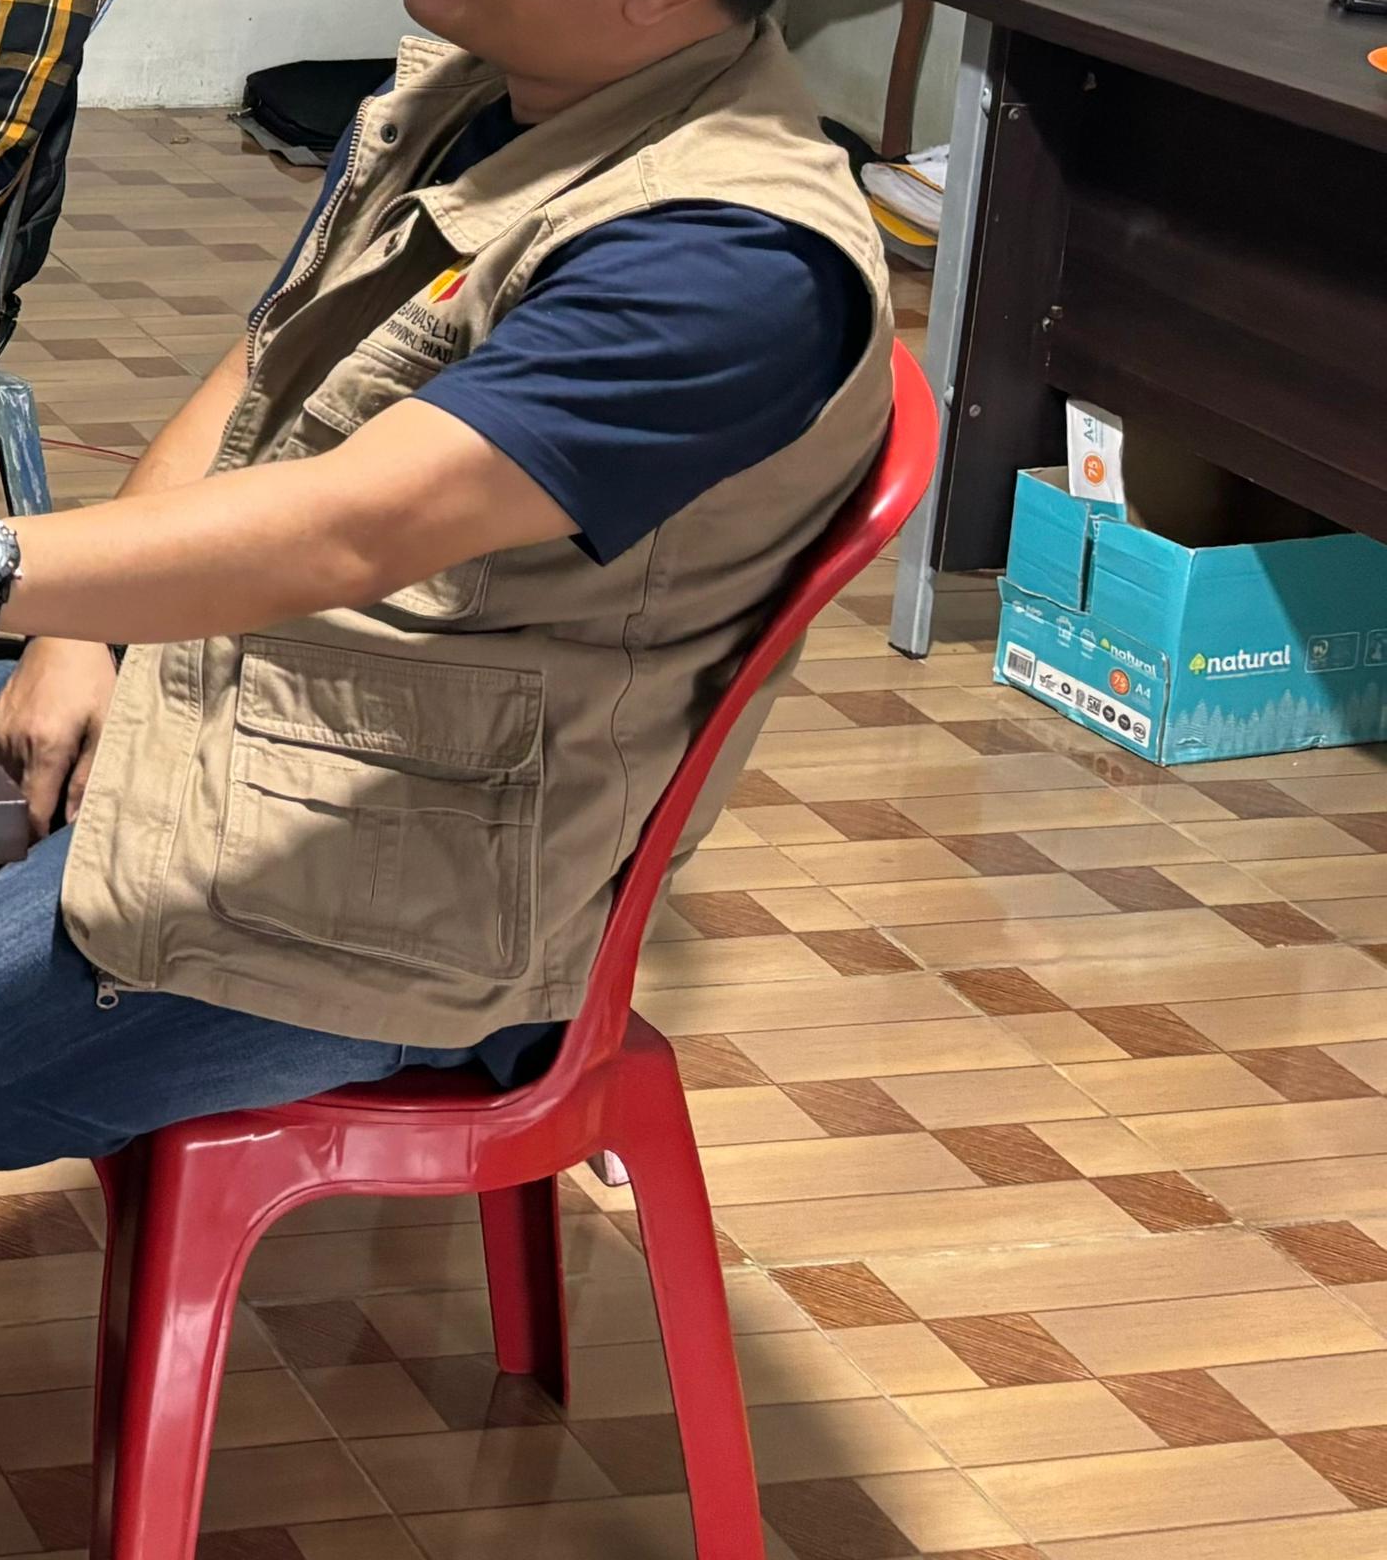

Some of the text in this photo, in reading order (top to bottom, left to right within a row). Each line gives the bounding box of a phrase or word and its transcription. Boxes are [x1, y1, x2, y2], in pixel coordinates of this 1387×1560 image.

[1110, 644, 1157, 679] natural
[1206, 644, 1291, 674] natural
[1135, 683, 1152, 700] A4
